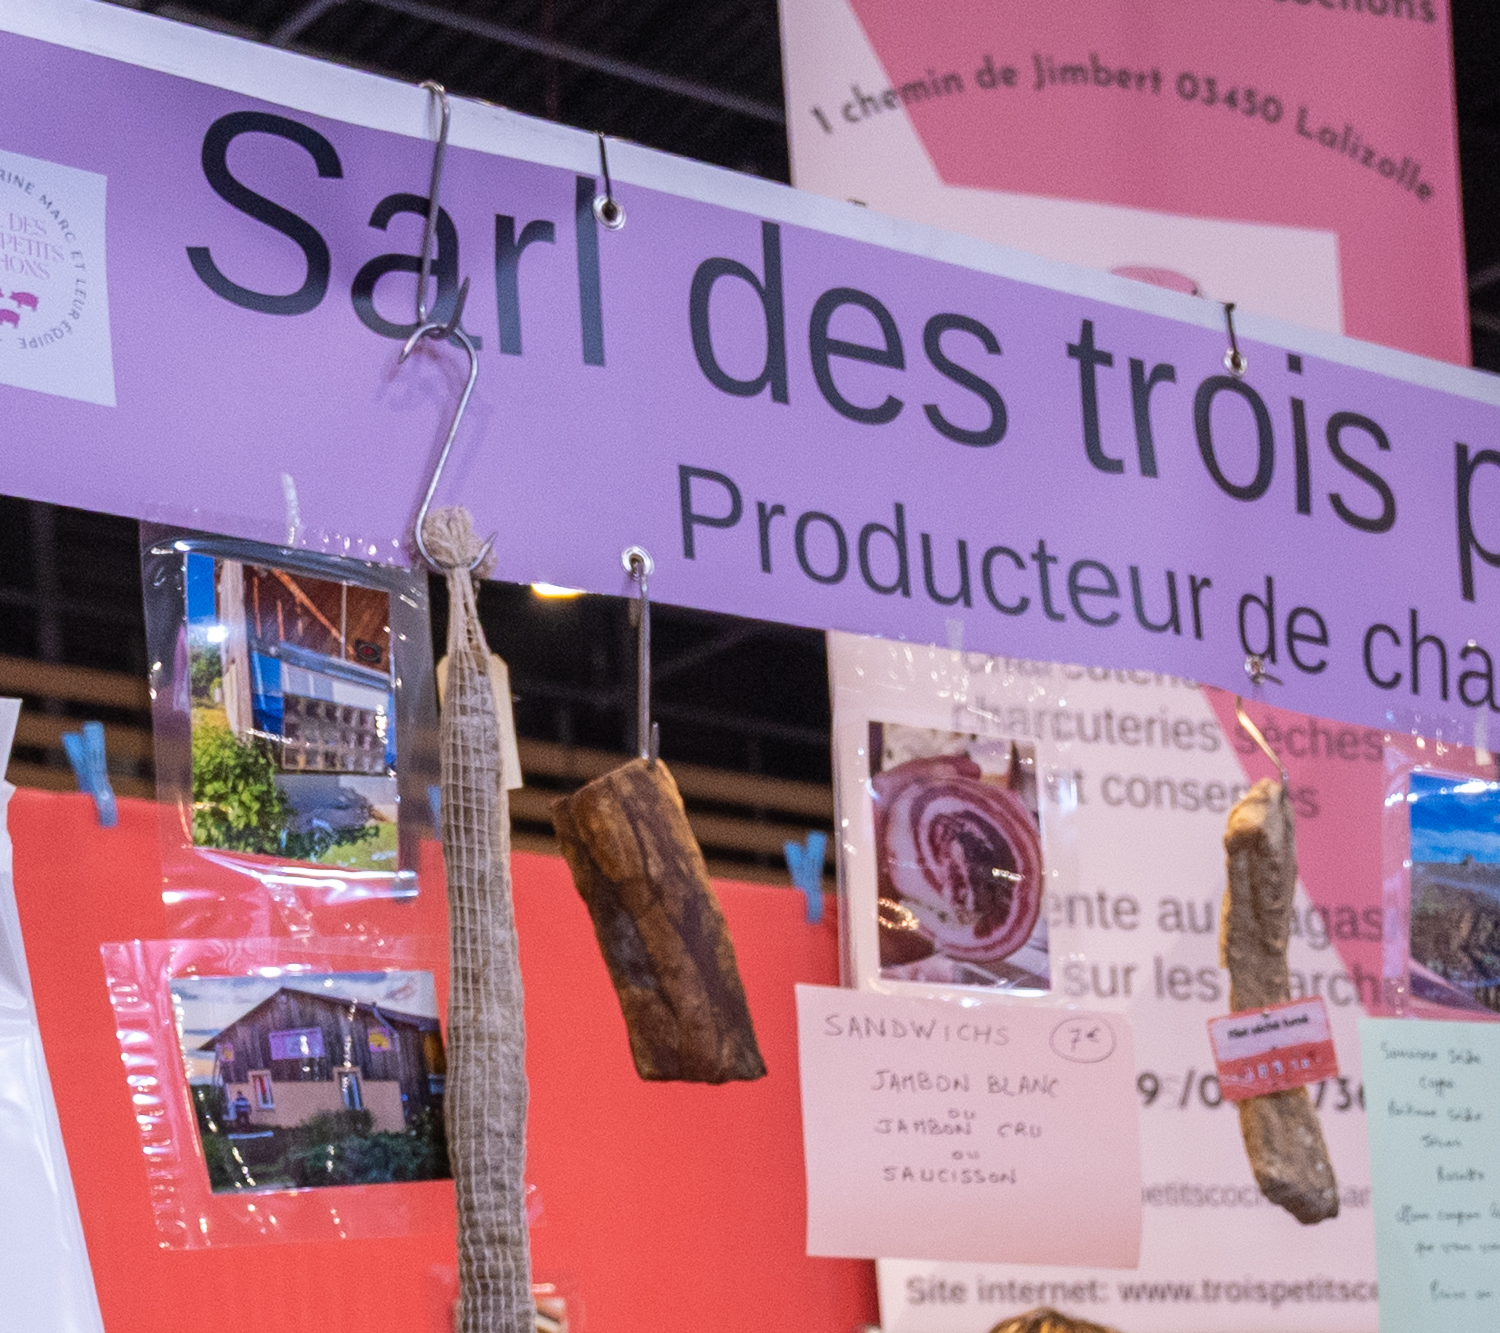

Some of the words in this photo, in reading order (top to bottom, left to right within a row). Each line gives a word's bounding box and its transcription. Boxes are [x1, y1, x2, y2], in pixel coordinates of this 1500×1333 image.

[810, 104, 833, 135] 1
[840, 68, 965, 126] chemin
[973, 54, 1020, 93] de
[1032, 52, 1163, 97] Jimbert
[1176, 71, 1284, 125] 03450
[1293, 107, 1436, 204] Lalizolle
[8, 211, 48, 237] DES
[38, 194, 77, 242] MARC
[0, 231, 66, 263] PETITS
[71, 250, 86, 270] ET
[68, 277, 87, 321] LEUR
[17, 318, 73, 350] ÉQUIPE
[185, 109, 609, 367] Sarl
[688, 219, 1010, 449] des
[1067, 319, 1399, 537] trois
[676, 461, 1211, 641] Producteur
[1237, 576, 1331, 677] de
[1233, 712, 1382, 761] sèches
[1042, 892, 1140, 932] ente
[1157, 897, 1213, 934] au
[1063, 952, 1135, 1000] sur
[1155, 954, 1220, 1004] les
[824, 1014, 1011, 1046] SANDWICHS
[871, 1070, 971, 1093] JAMBON
[986, 1074, 1060, 1098] BLANC
[874, 1118, 972, 1135] JAMBON
[997, 1123, 1042, 1139] CRU
[882, 1166, 1017, 1185] SAUCISSON
[906, 1277, 966, 1305] Site
[978, 1278, 1109, 1306] internet:
